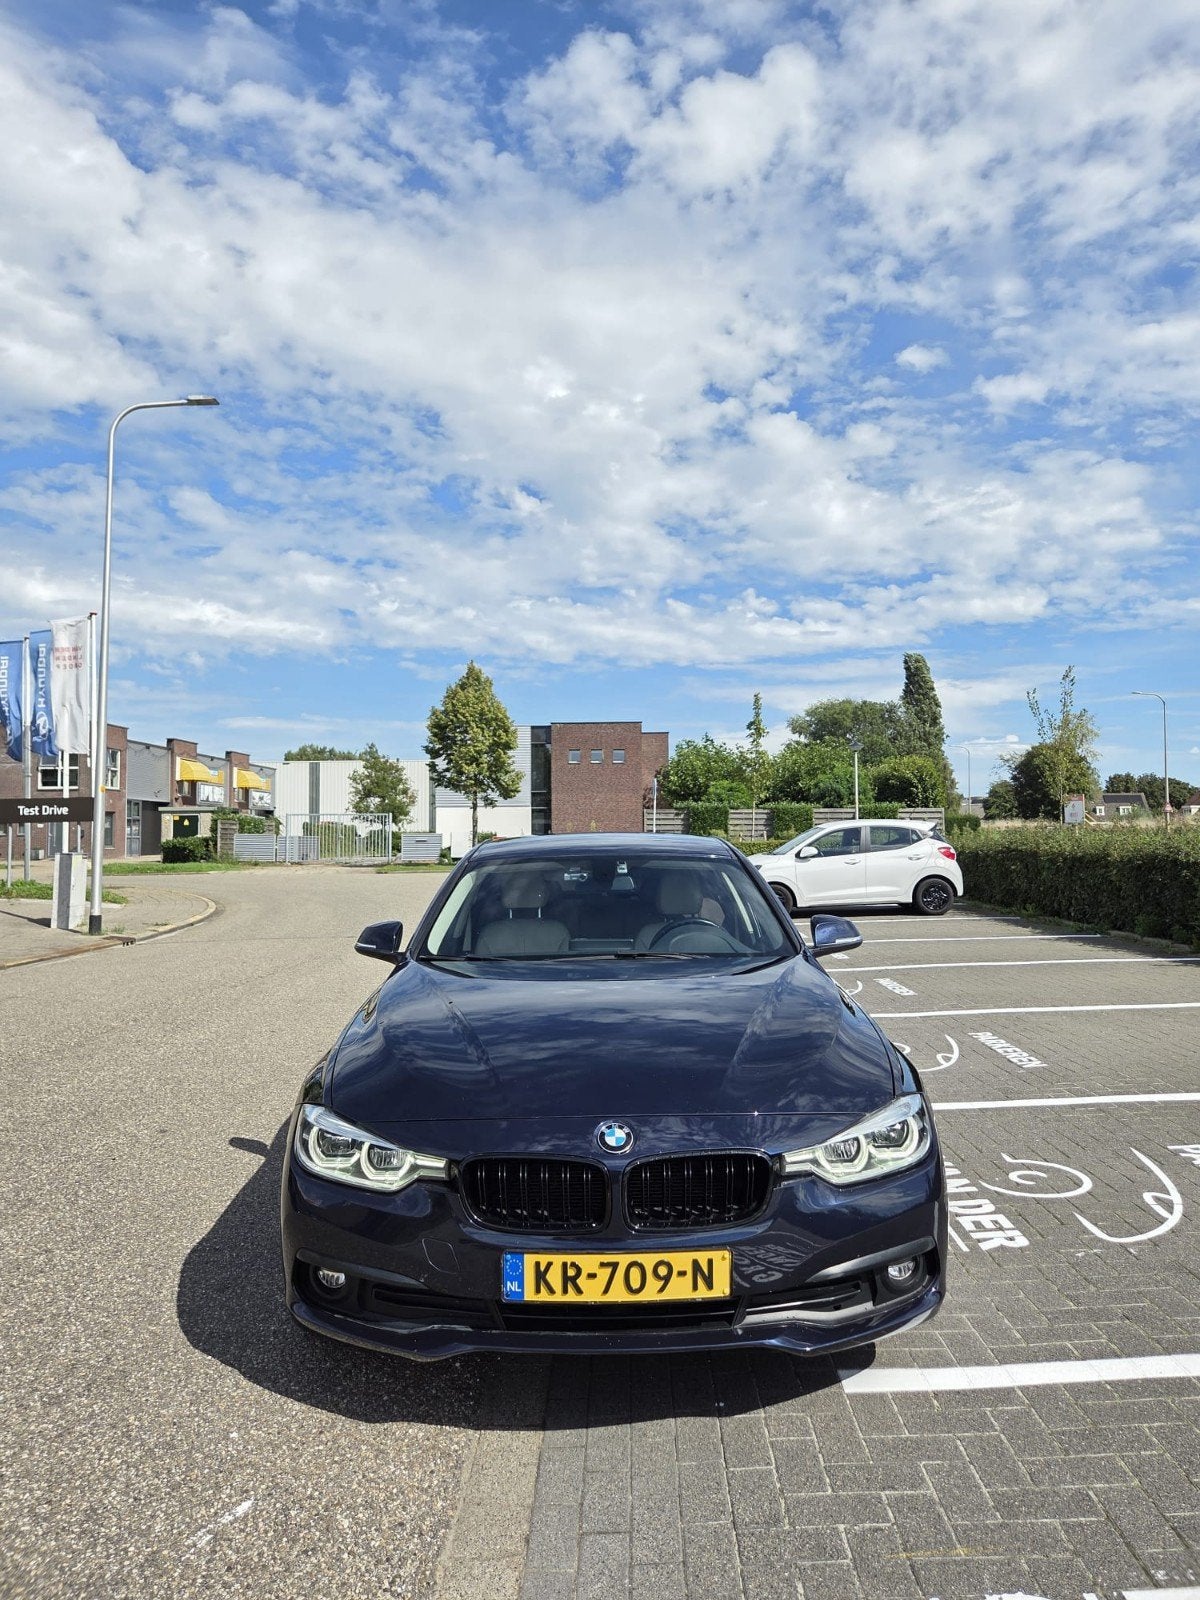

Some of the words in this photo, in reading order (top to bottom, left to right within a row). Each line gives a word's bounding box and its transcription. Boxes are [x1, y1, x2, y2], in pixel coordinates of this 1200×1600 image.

[17, 805, 40, 816] Test
[41, 805, 69, 816] Drive
[967, 1032, 1048, 1068] PARKEREN
[507, 1280, 521, 1292] NL
[534, 1257, 714, 1296] KR-709-N
